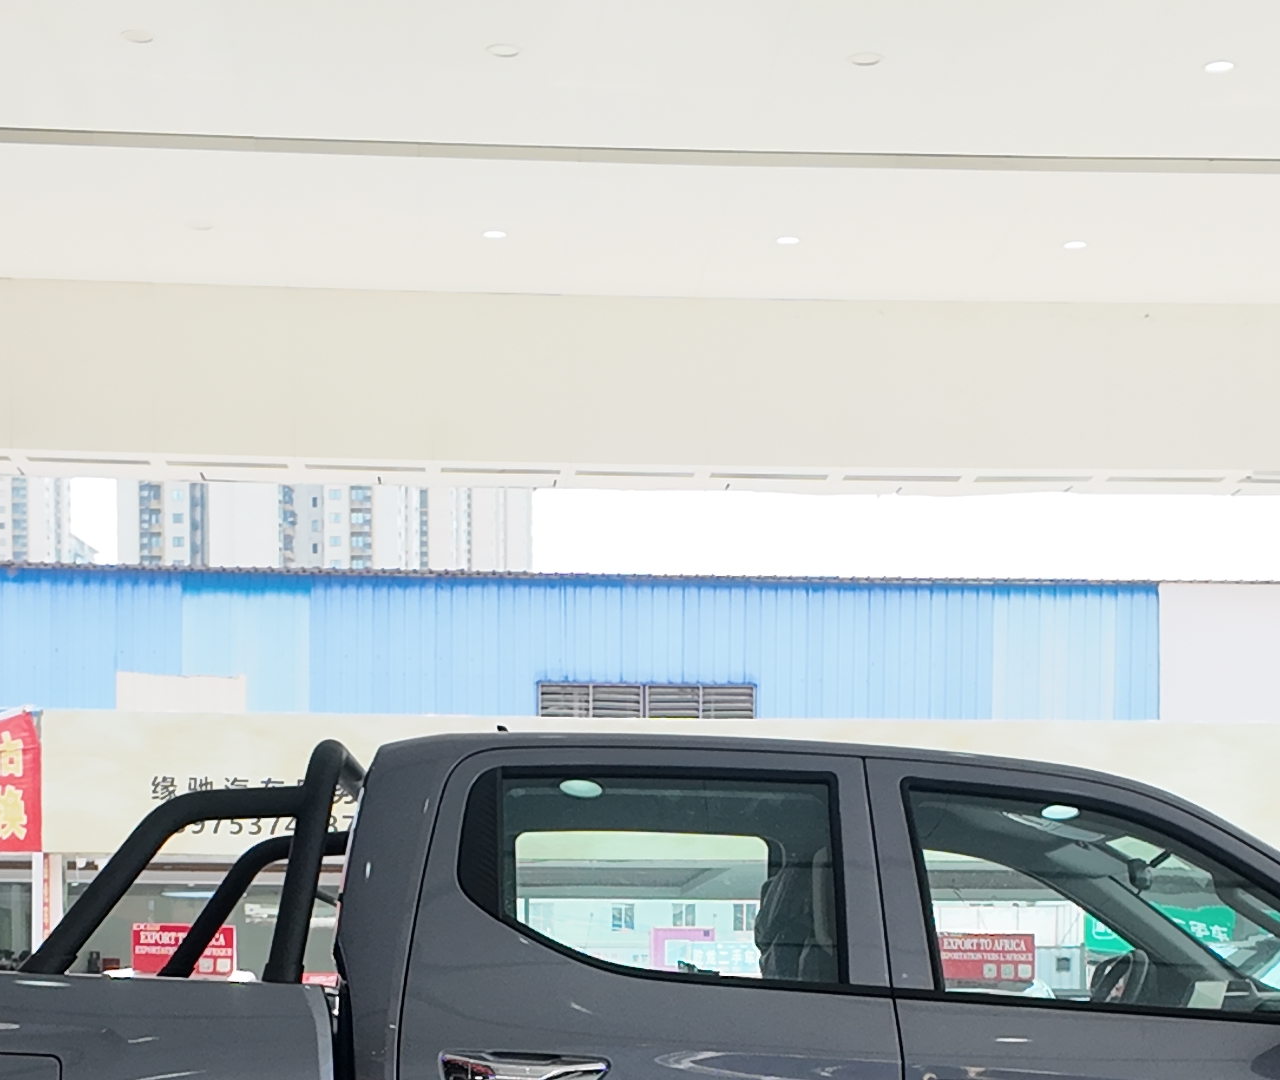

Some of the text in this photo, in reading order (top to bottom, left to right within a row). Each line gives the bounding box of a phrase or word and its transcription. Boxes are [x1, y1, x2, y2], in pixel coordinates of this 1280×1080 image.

[140, 931, 177, 944] EXPORT
[943, 938, 1026, 951] EXPORT TO AFRICA
